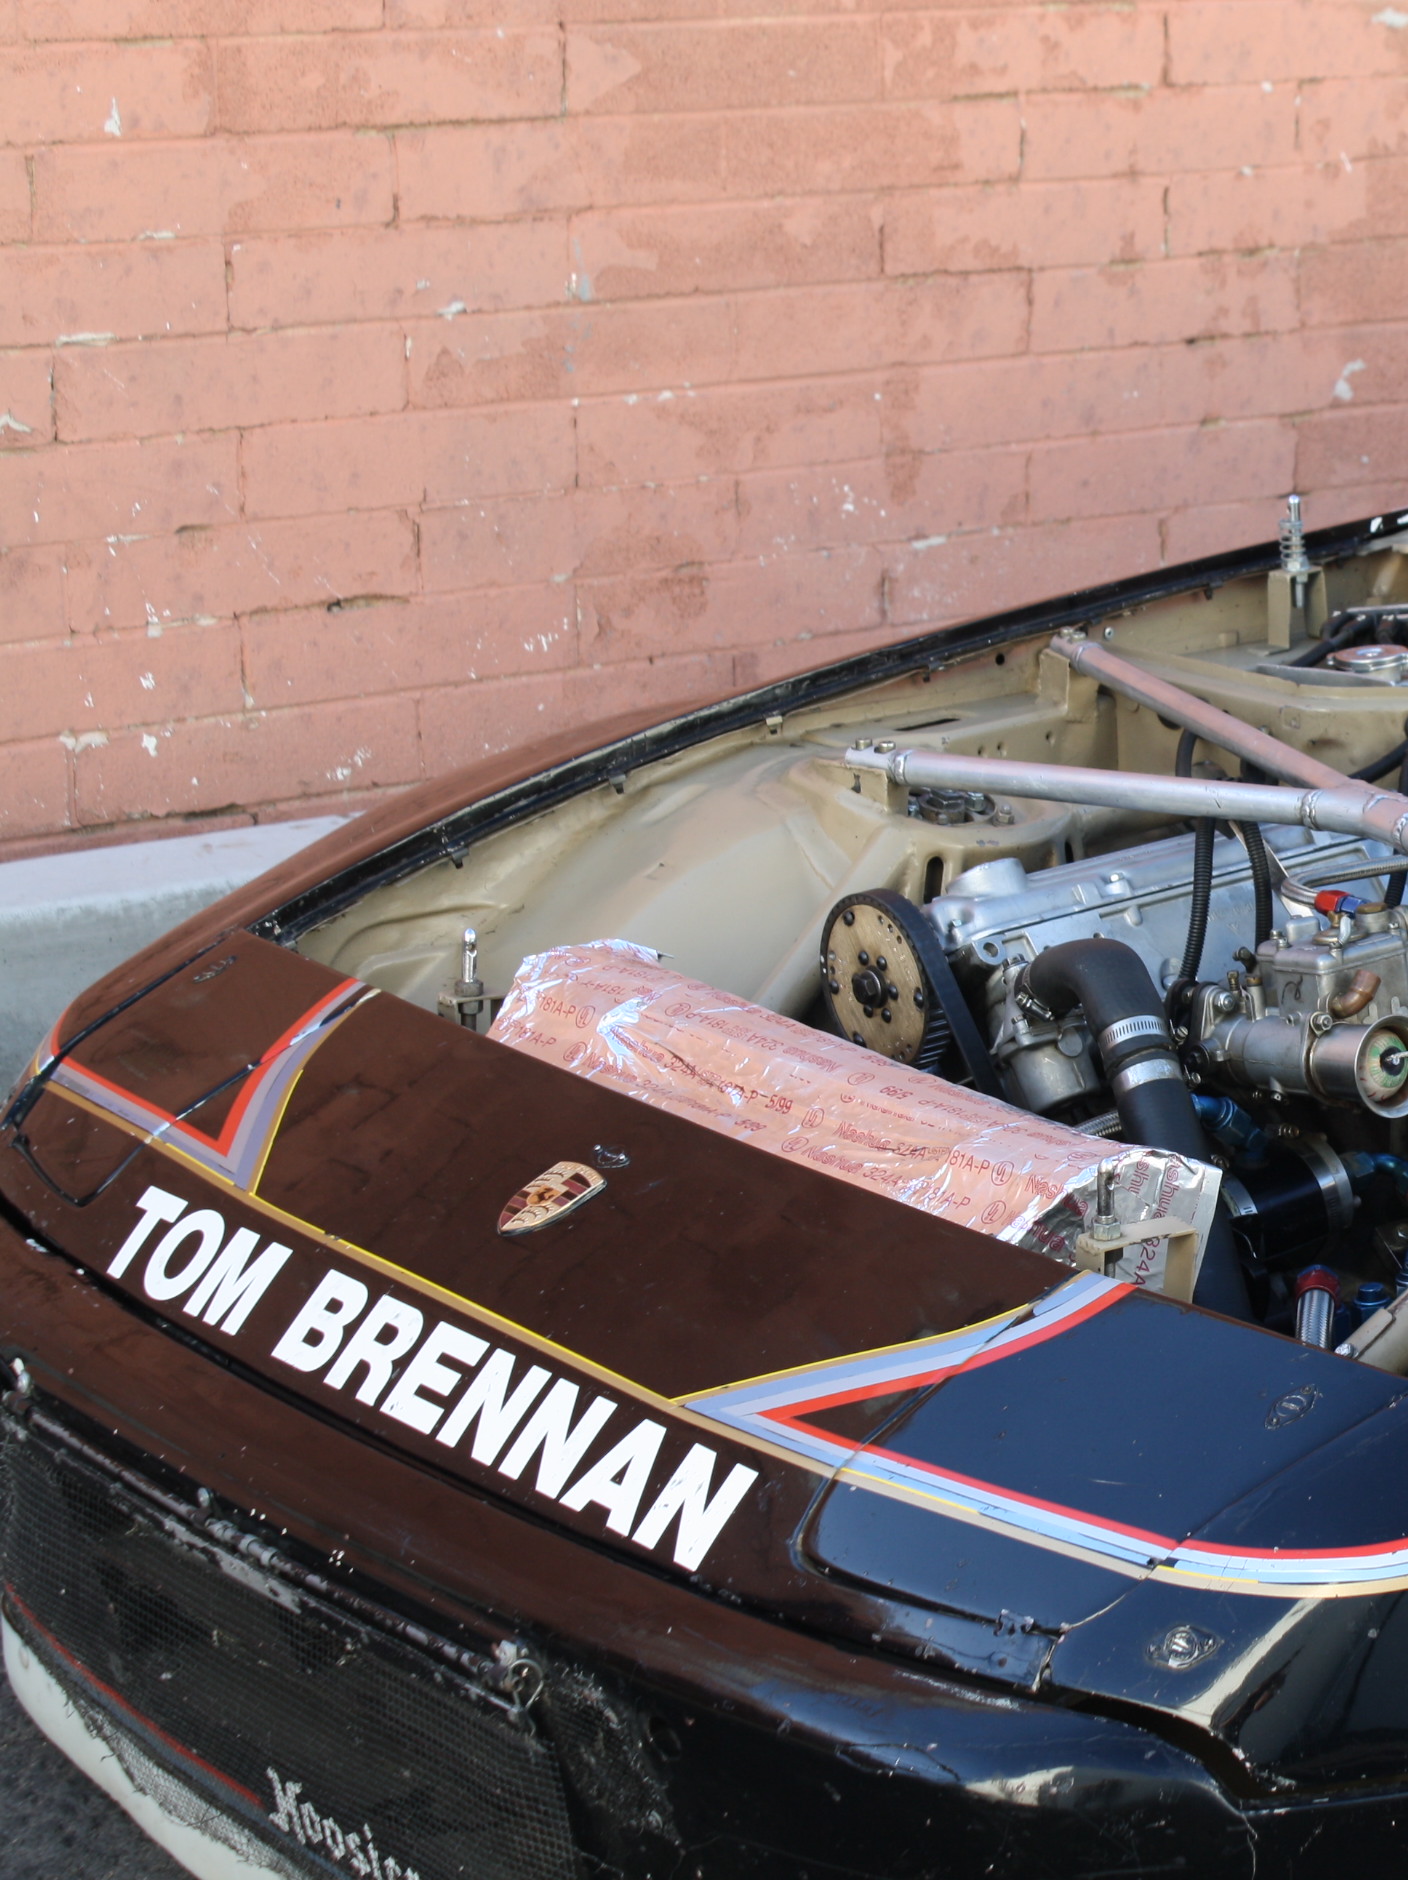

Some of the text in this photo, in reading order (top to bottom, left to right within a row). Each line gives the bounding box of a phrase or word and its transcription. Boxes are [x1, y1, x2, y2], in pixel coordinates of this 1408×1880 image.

[765, 1096, 793, 1114] 5/99
[832, 1120, 892, 1151] Nashua
[105, 1184, 760, 1573] TOM BRENNAN
